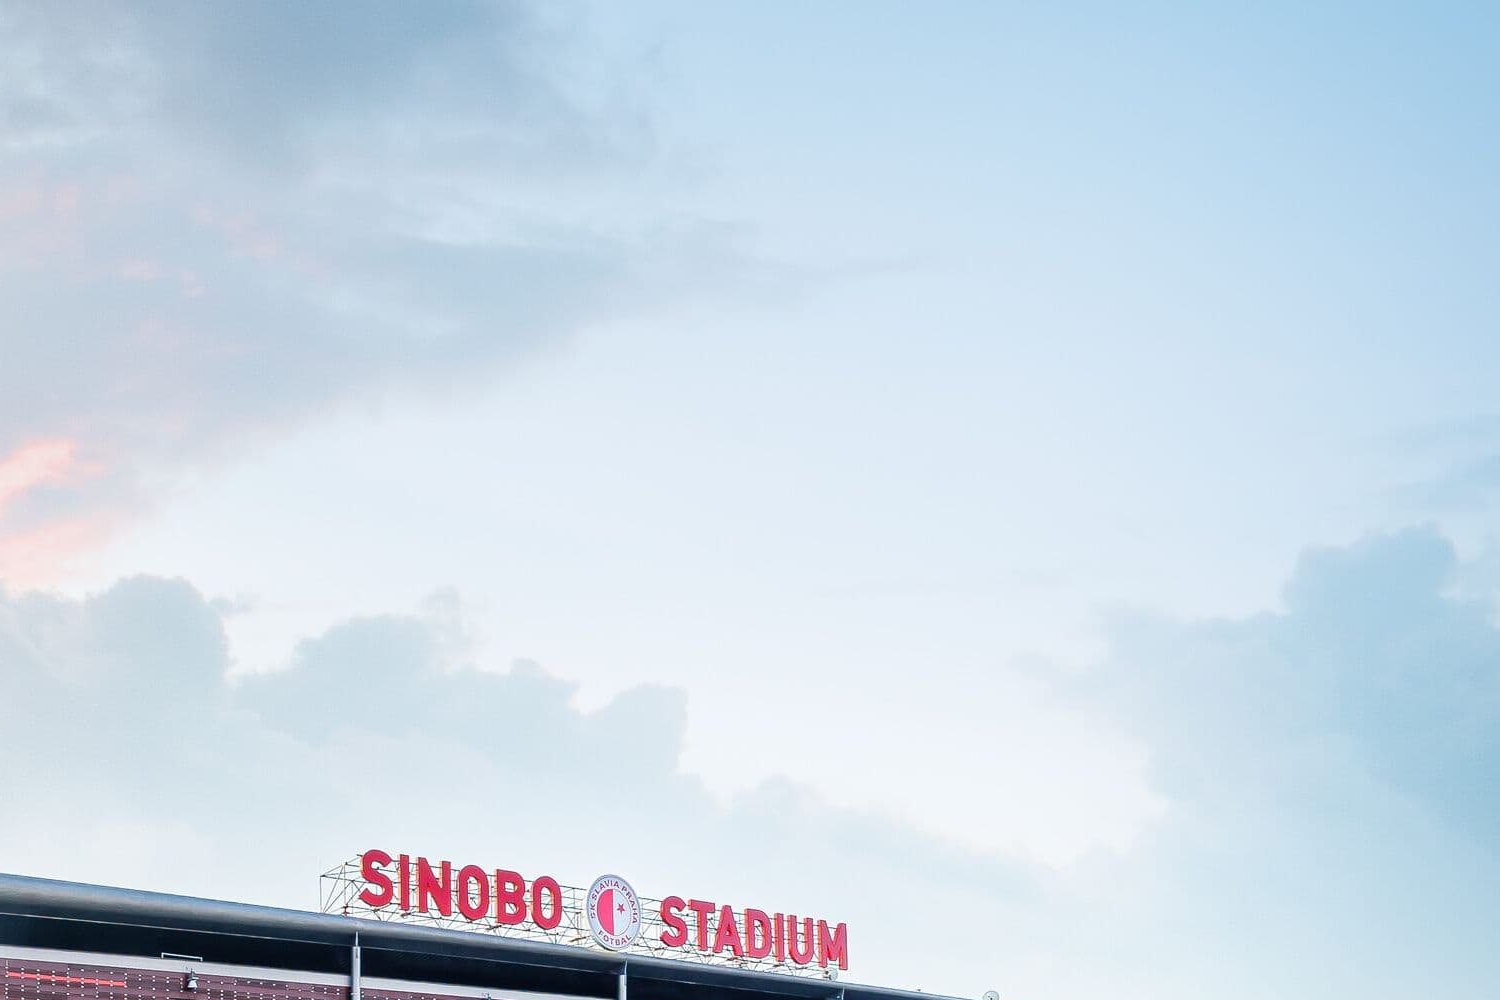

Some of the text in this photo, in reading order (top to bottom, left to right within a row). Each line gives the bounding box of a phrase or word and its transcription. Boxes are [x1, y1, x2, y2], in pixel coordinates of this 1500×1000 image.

[592, 880, 620, 900] SLAVIA
[359, 849, 848, 971] SINOBO STADIUM
[598, 930, 632, 946] FOTBAL
